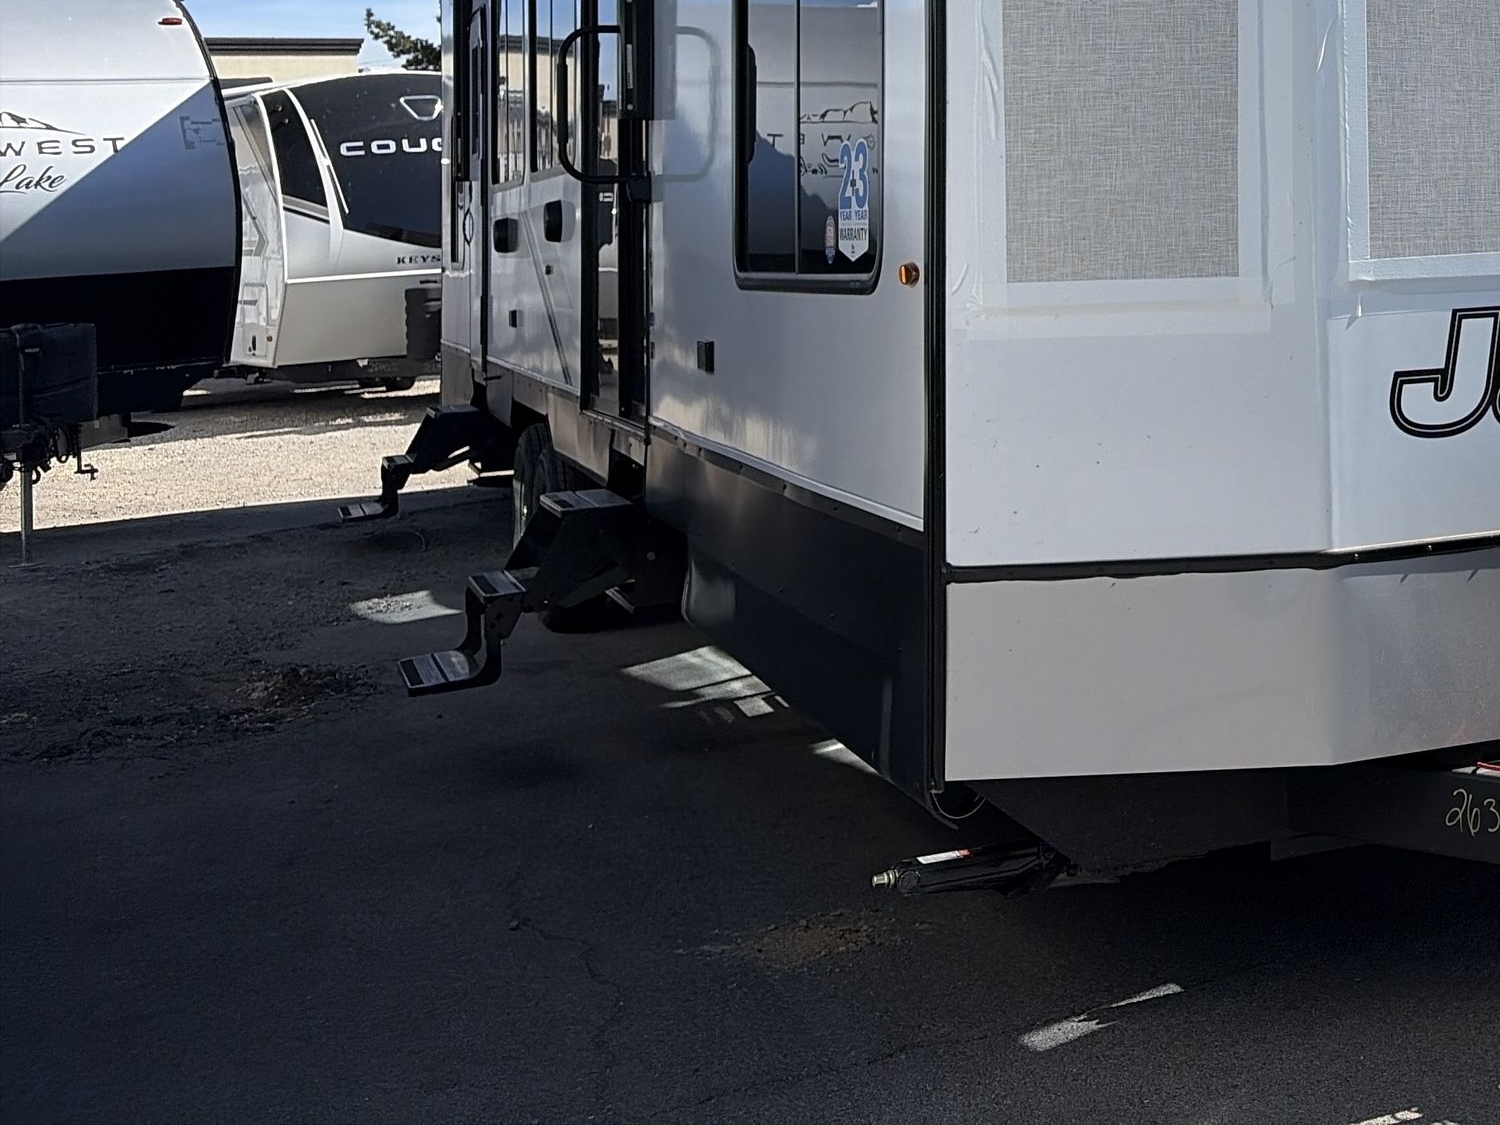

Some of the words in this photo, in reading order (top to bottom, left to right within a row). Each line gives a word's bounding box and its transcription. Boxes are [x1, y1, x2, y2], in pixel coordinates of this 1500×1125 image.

[839, 209, 853, 221] YEAR
[854, 209, 868, 221] YEAR
[839, 227, 868, 241] WARRANTY
